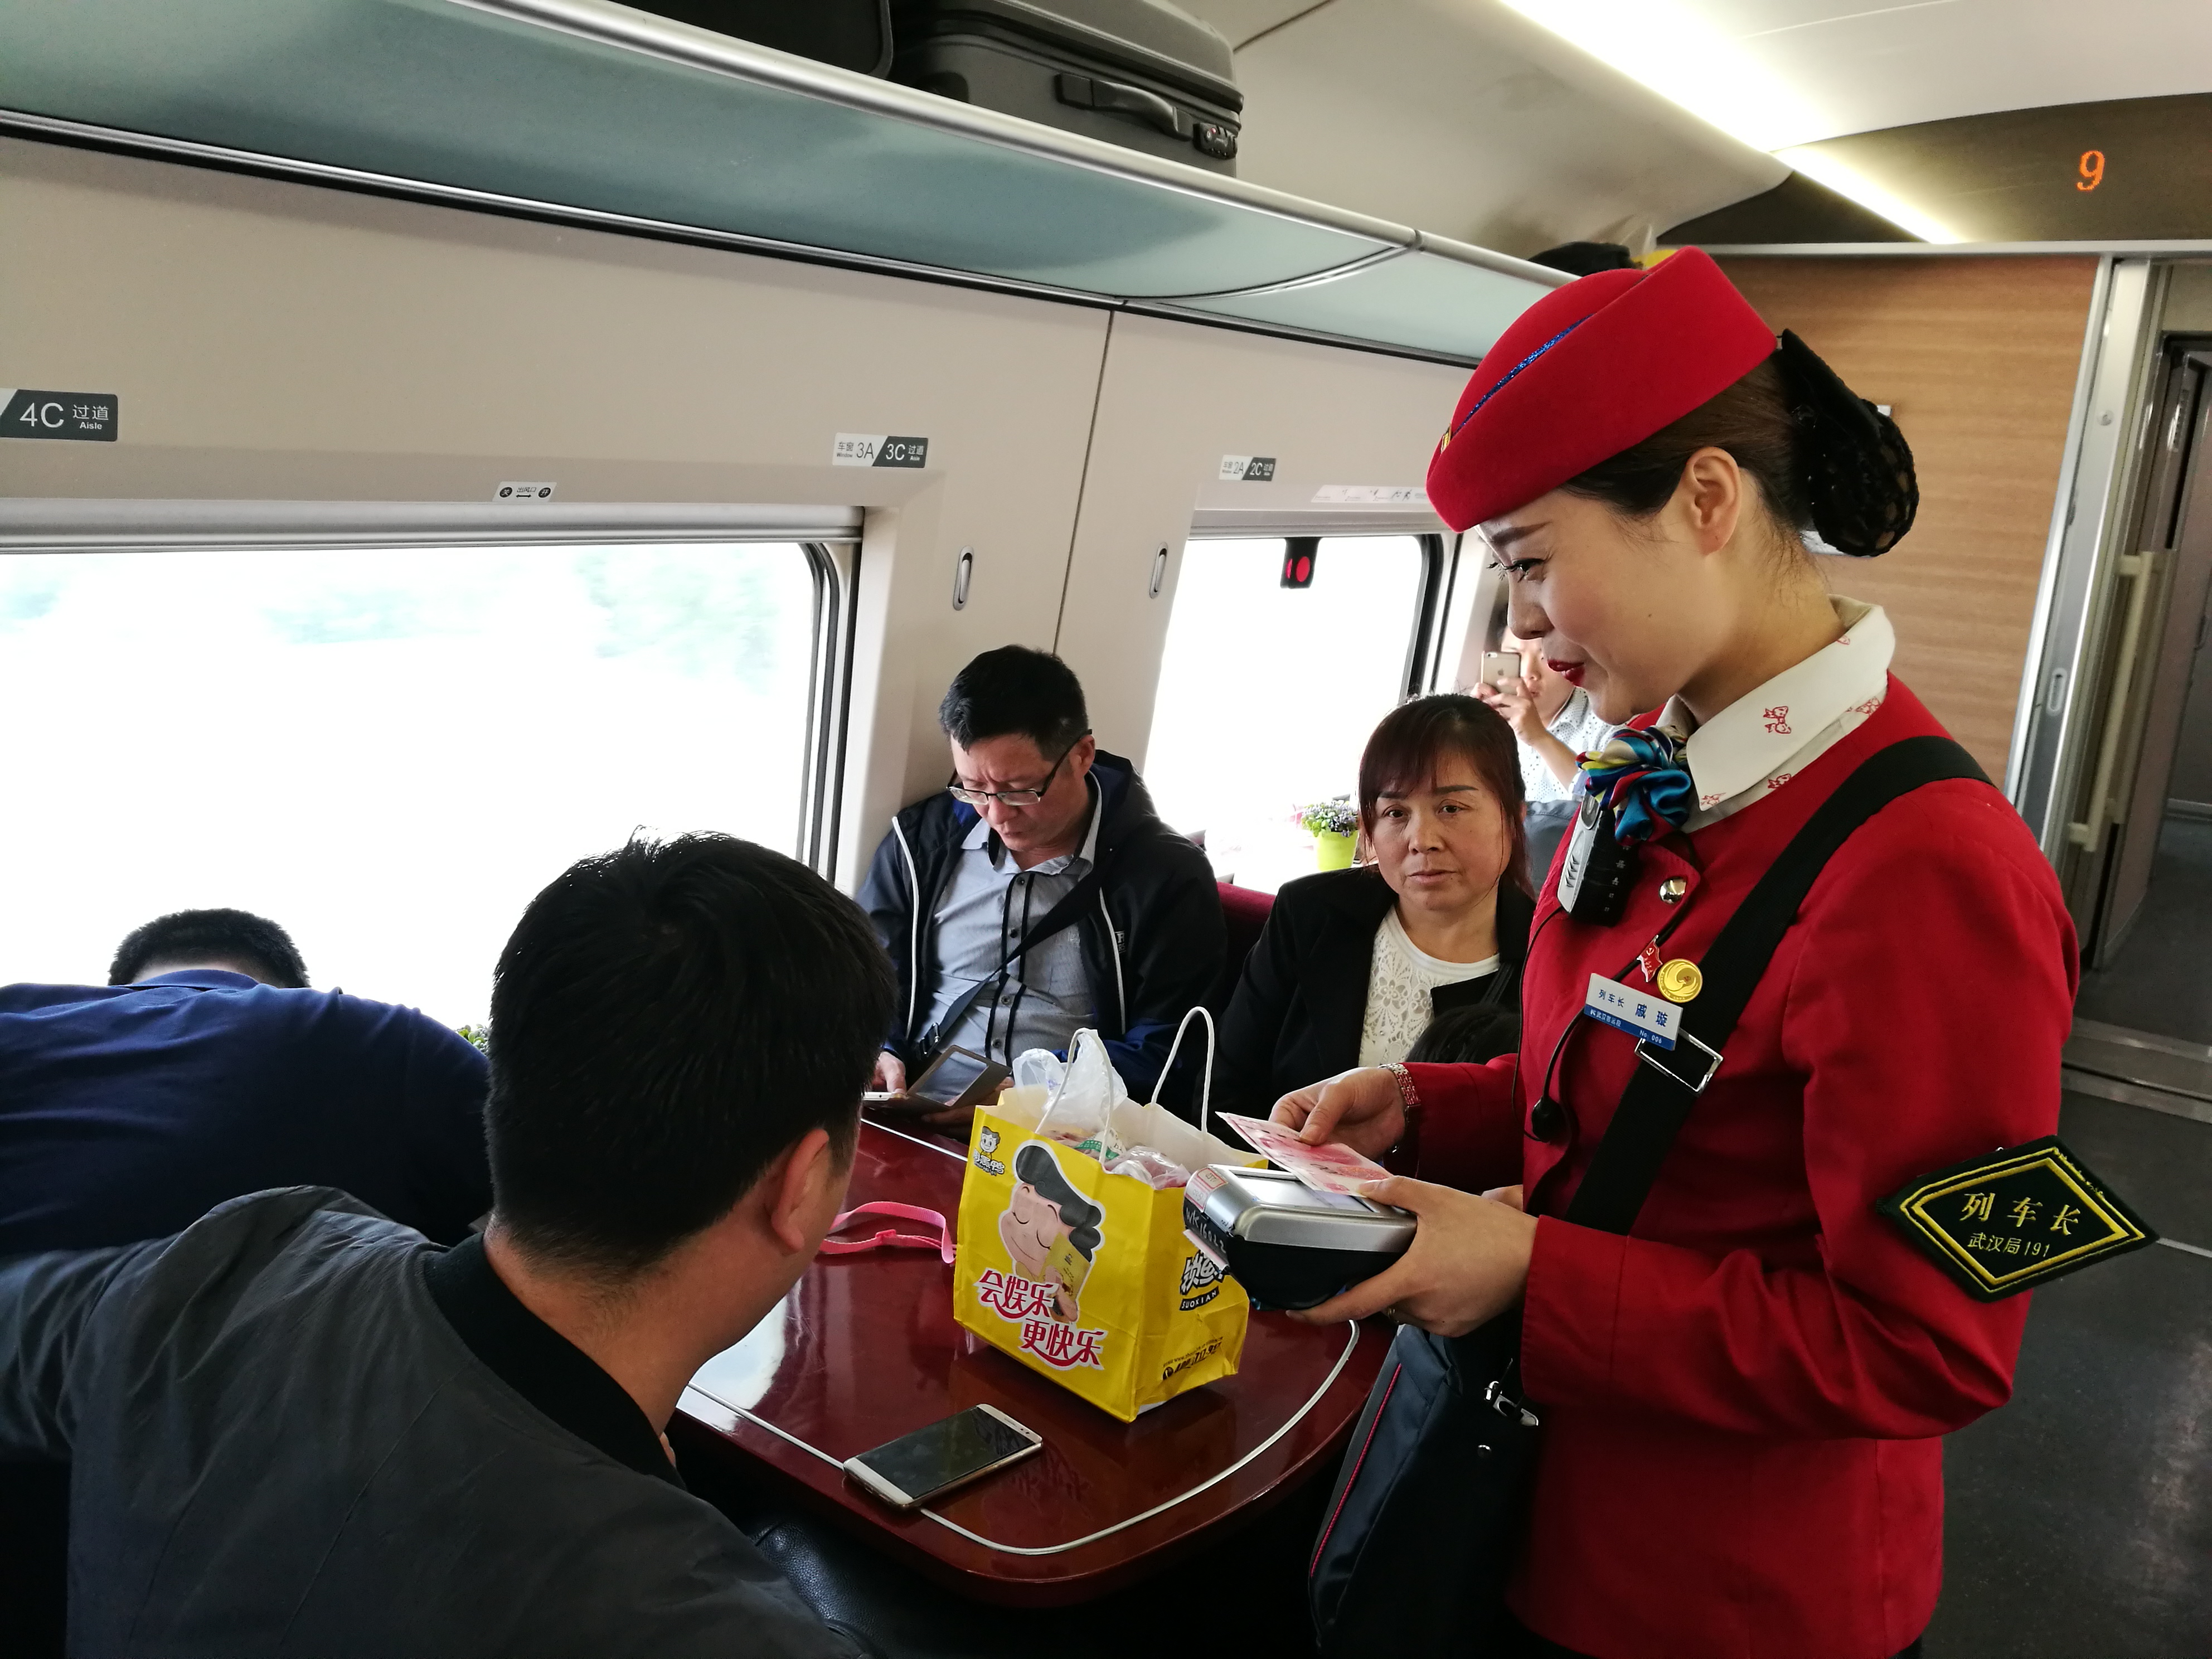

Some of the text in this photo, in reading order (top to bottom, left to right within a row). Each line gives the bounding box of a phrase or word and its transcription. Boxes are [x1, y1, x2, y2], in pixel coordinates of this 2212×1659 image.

[2076, 150, 2105, 191] 9
[20, 402, 109, 428] 4C 过道
[838, 442, 854, 452] 车窗
[856, 442, 874, 459] 3A
[886, 444, 905, 460] 3C
[1233, 462, 1244, 474] 2A
[1249, 462, 1263, 476] 2C
[1598, 989, 1624, 1008] 列车长
[1651, 1035, 1662, 1044] 006
[1959, 1192, 2081, 1236] 列车长
[979, 1270, 1054, 1320] 会娱乐
[1181, 1288, 1217, 1309] SUOXIAN
[1021, 1318, 1104, 1367] 更快乐
